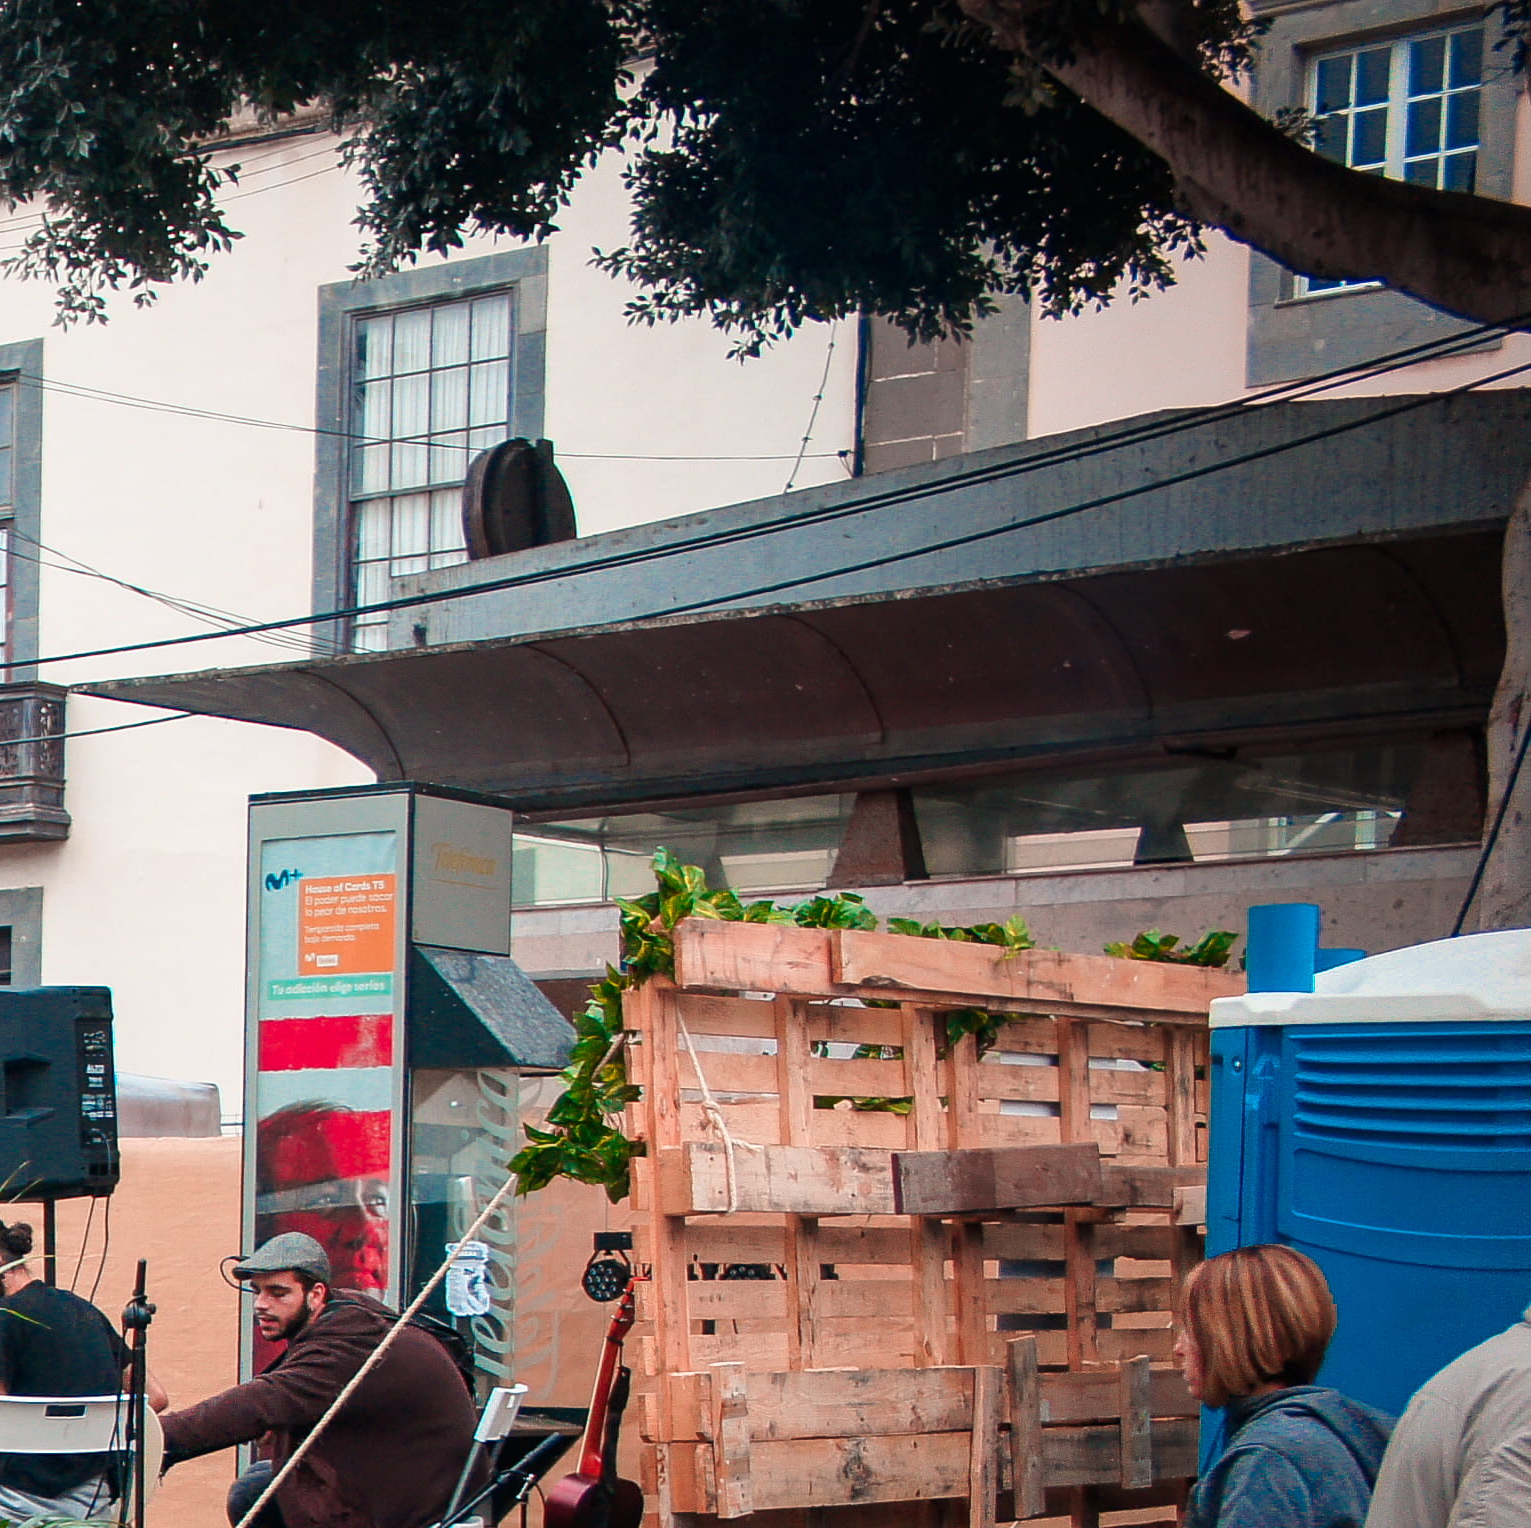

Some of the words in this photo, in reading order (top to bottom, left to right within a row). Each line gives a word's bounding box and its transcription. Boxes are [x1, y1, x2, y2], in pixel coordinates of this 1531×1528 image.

[305, 885, 332, 894] House
[333, 883, 343, 892] of
[344, 881, 370, 891] Cards
[272, 984, 284, 995] Tu
